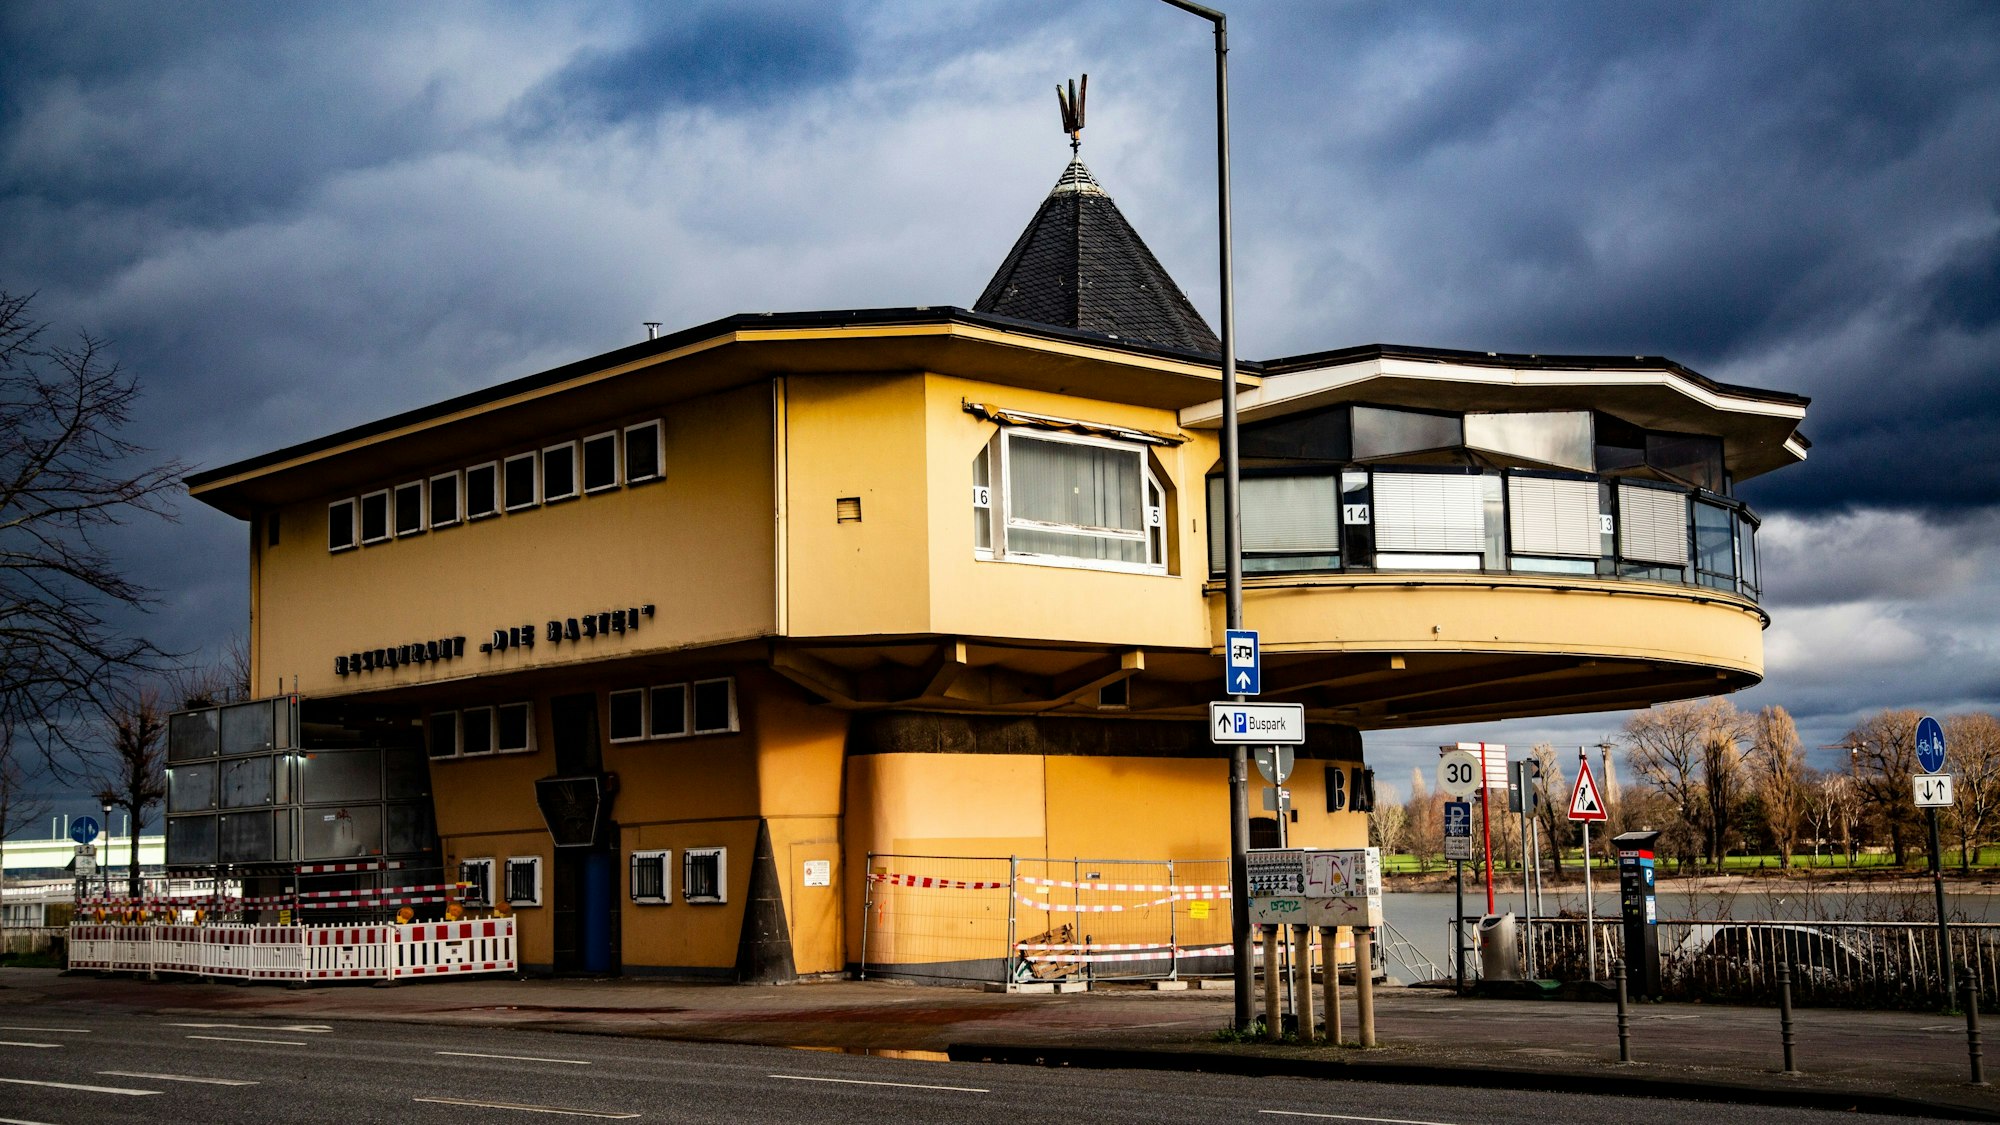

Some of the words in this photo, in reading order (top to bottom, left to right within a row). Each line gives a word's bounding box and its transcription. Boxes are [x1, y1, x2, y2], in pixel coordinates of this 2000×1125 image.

[1346, 507, 1368, 521] 14
[1600, 517, 1612, 531] 13
[335, 636, 466, 675] RESTAURANT
[1249, 716, 1287, 734] Buspark
[1446, 763, 1472, 784] 30
[1325, 766, 1375, 813] BA
[1646, 868, 1653, 883] P
